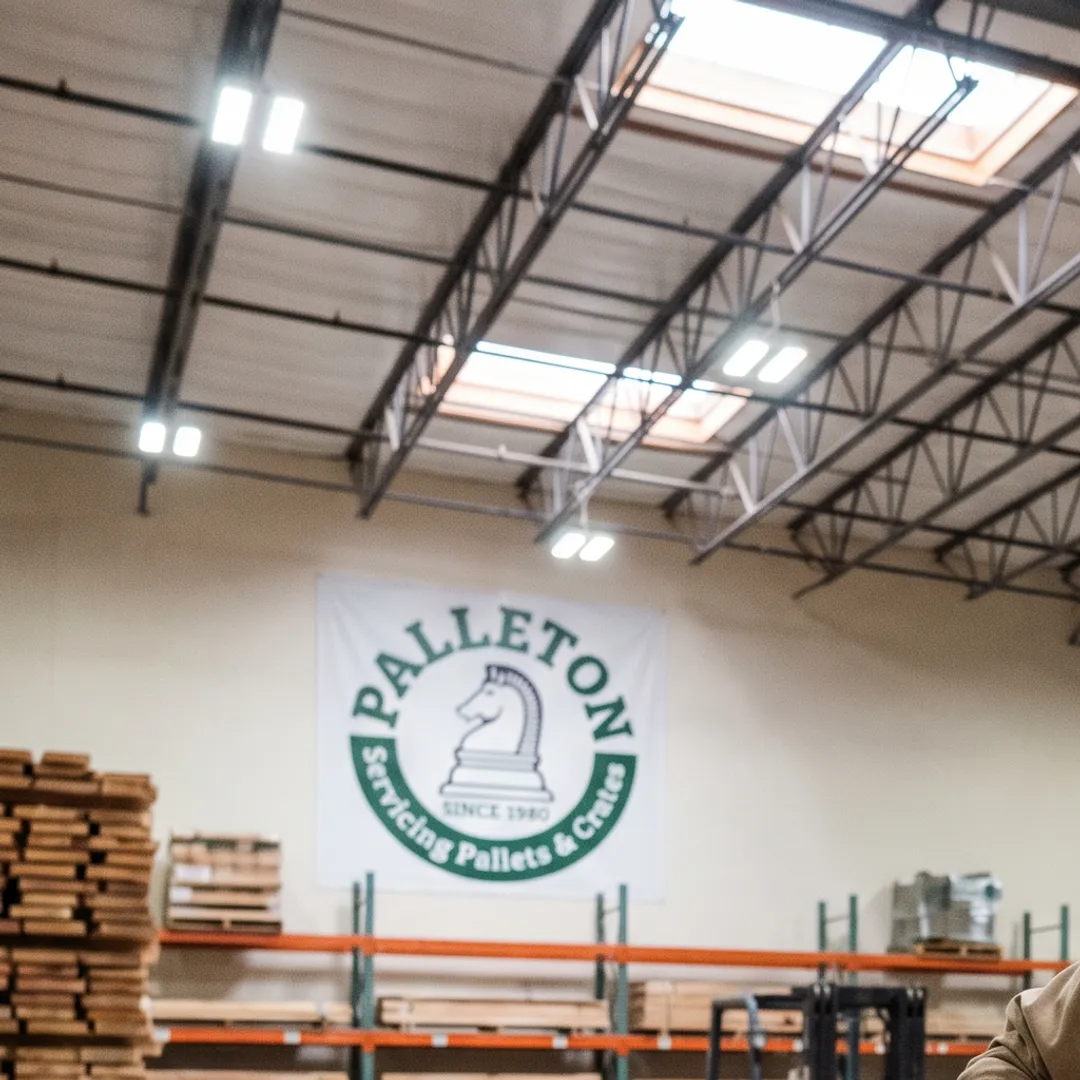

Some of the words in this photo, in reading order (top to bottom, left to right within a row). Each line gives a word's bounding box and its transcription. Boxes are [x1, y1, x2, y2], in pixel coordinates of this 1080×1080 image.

[352, 606, 634, 744] PALLETON
[362, 745, 454, 864] Servicing
[455, 844, 553, 872] Pallets
[554, 831, 579, 857] &
[571, 762, 627, 840] Crates
[443, 801, 501, 820] SINCE
